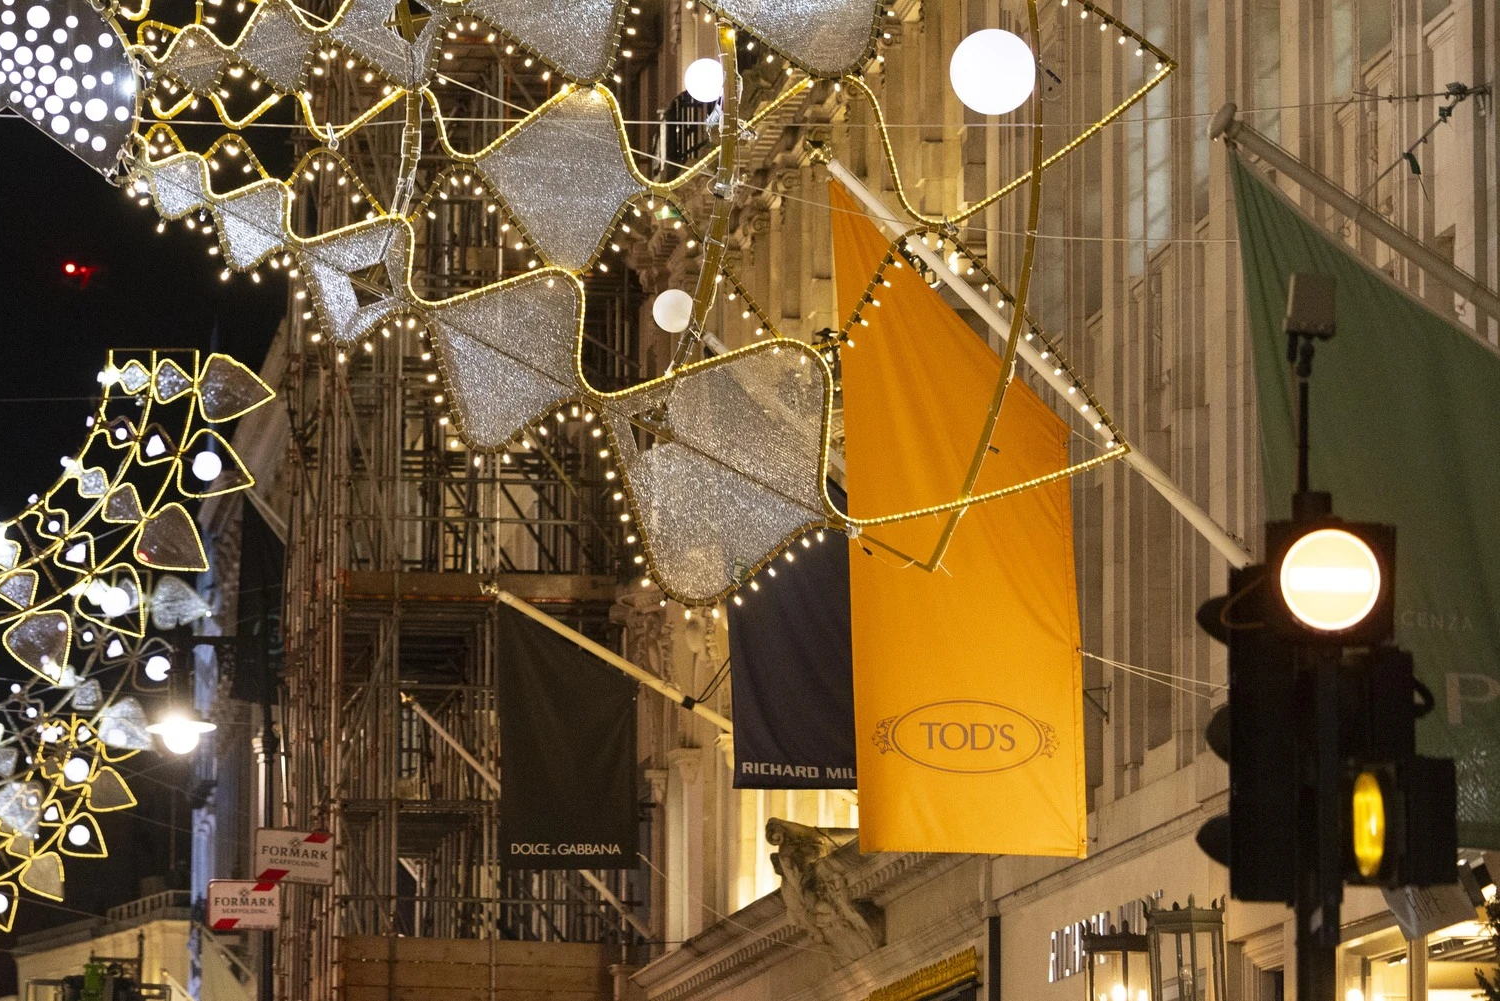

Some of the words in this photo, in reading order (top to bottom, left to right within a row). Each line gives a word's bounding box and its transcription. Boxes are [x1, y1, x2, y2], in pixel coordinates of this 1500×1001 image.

[918, 721, 1016, 752] TOD'S
[742, 761, 820, 779] RICHARD
[261, 845, 329, 860] FORMARK
[214, 897, 275, 907] FORMARK
